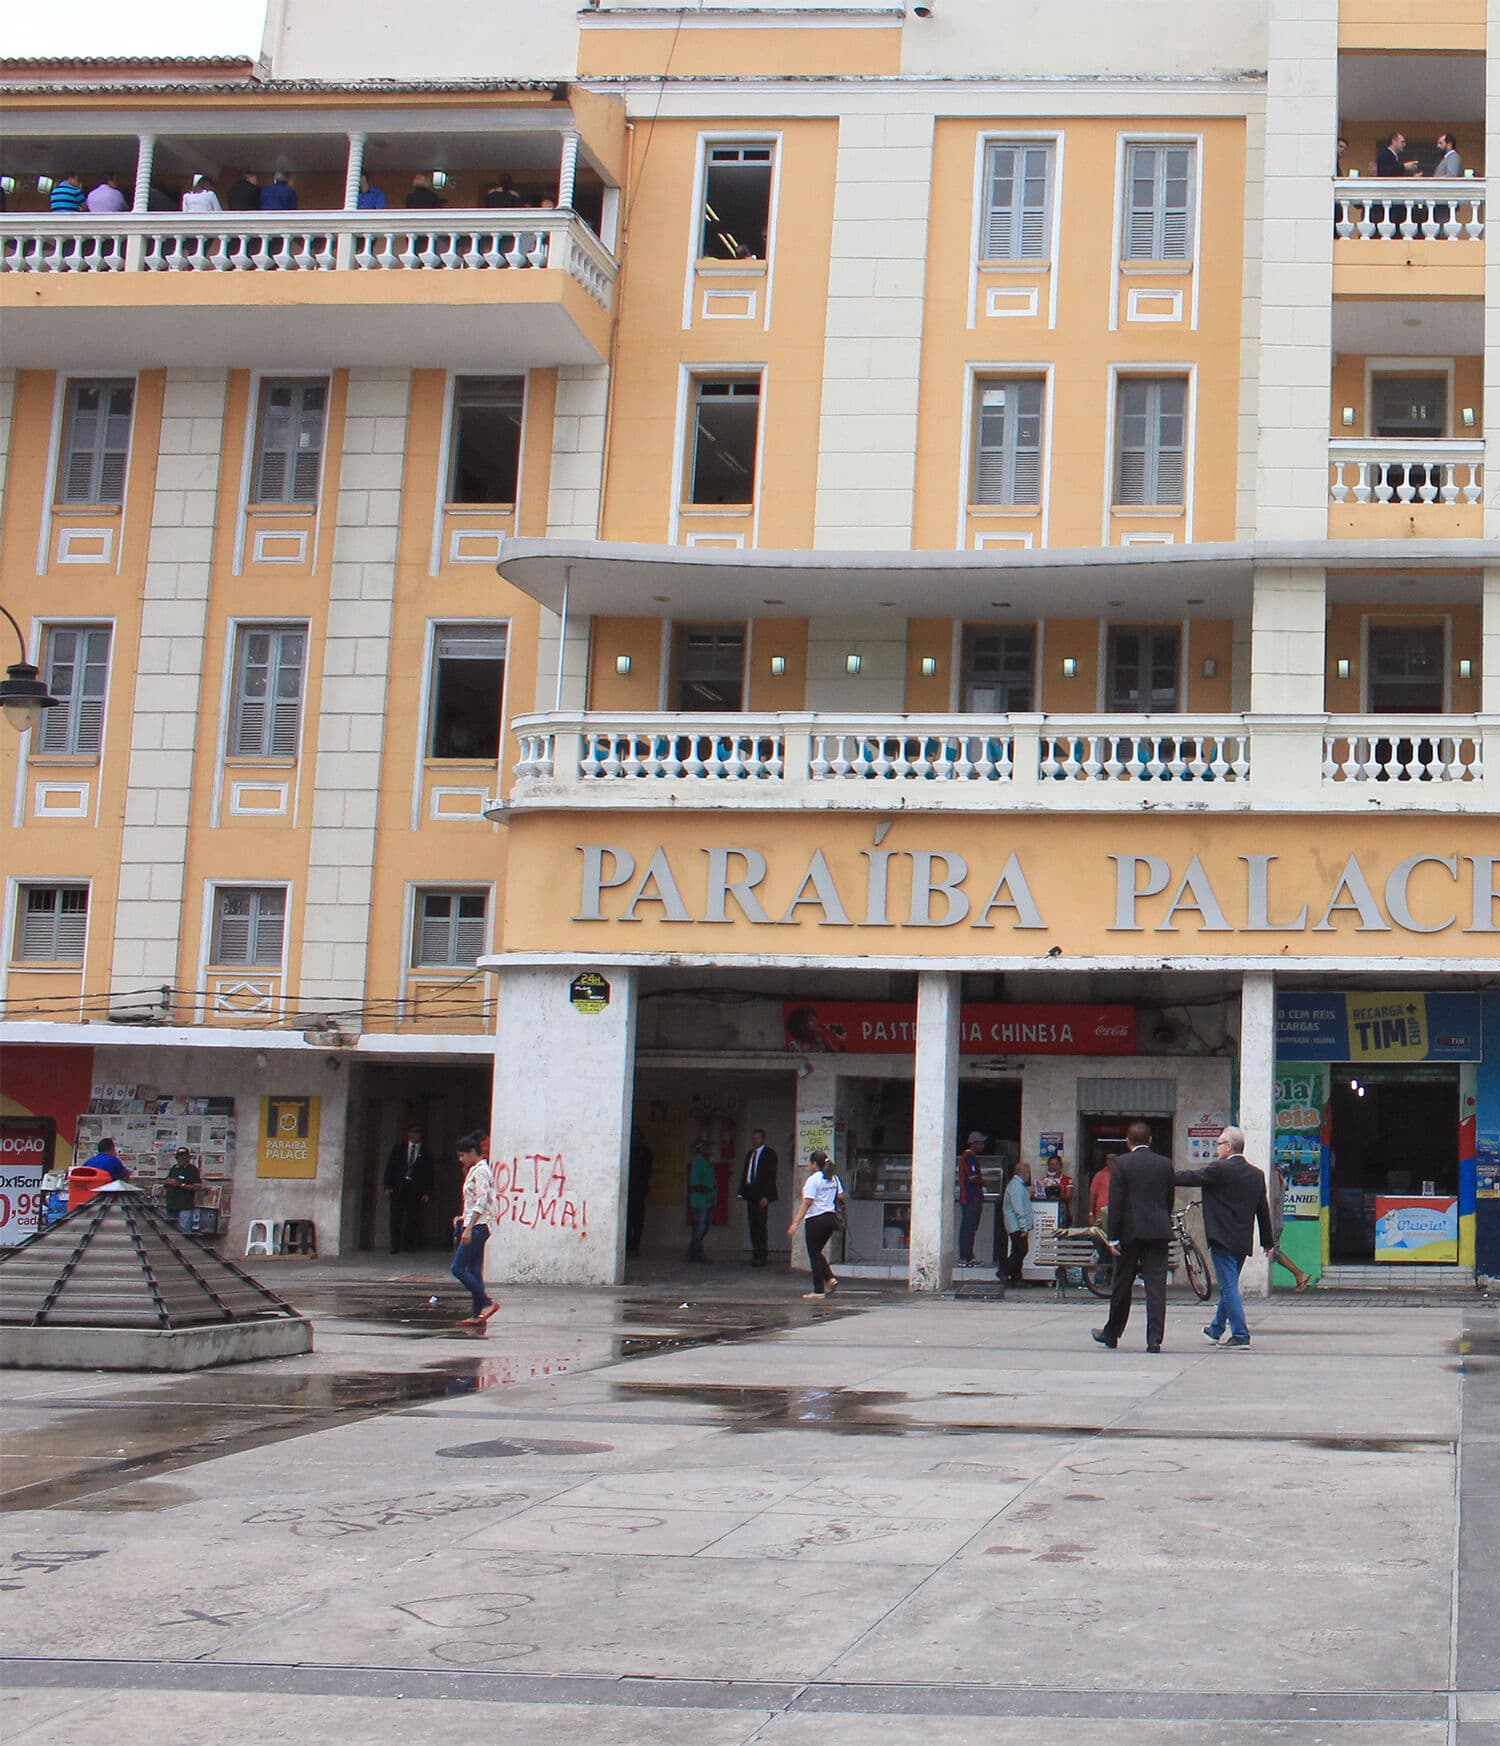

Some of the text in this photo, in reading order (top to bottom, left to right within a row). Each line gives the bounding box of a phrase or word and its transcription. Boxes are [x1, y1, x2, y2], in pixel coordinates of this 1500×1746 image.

[572, 823, 1047, 931] PARAÍBA
[1353, 1005, 1403, 1019] RECARGA
[1277, 1023, 1320, 1031] CARGAS
[991, 1023, 1074, 1043] CHINESA
[1354, 1018, 1408, 1051] TIM
[800, 1129, 833, 1137] CALDO
[809, 1137, 823, 1145] DE
[266, 1149, 308, 1160] PALACE
[17, 1216, 39, 1226] cad
